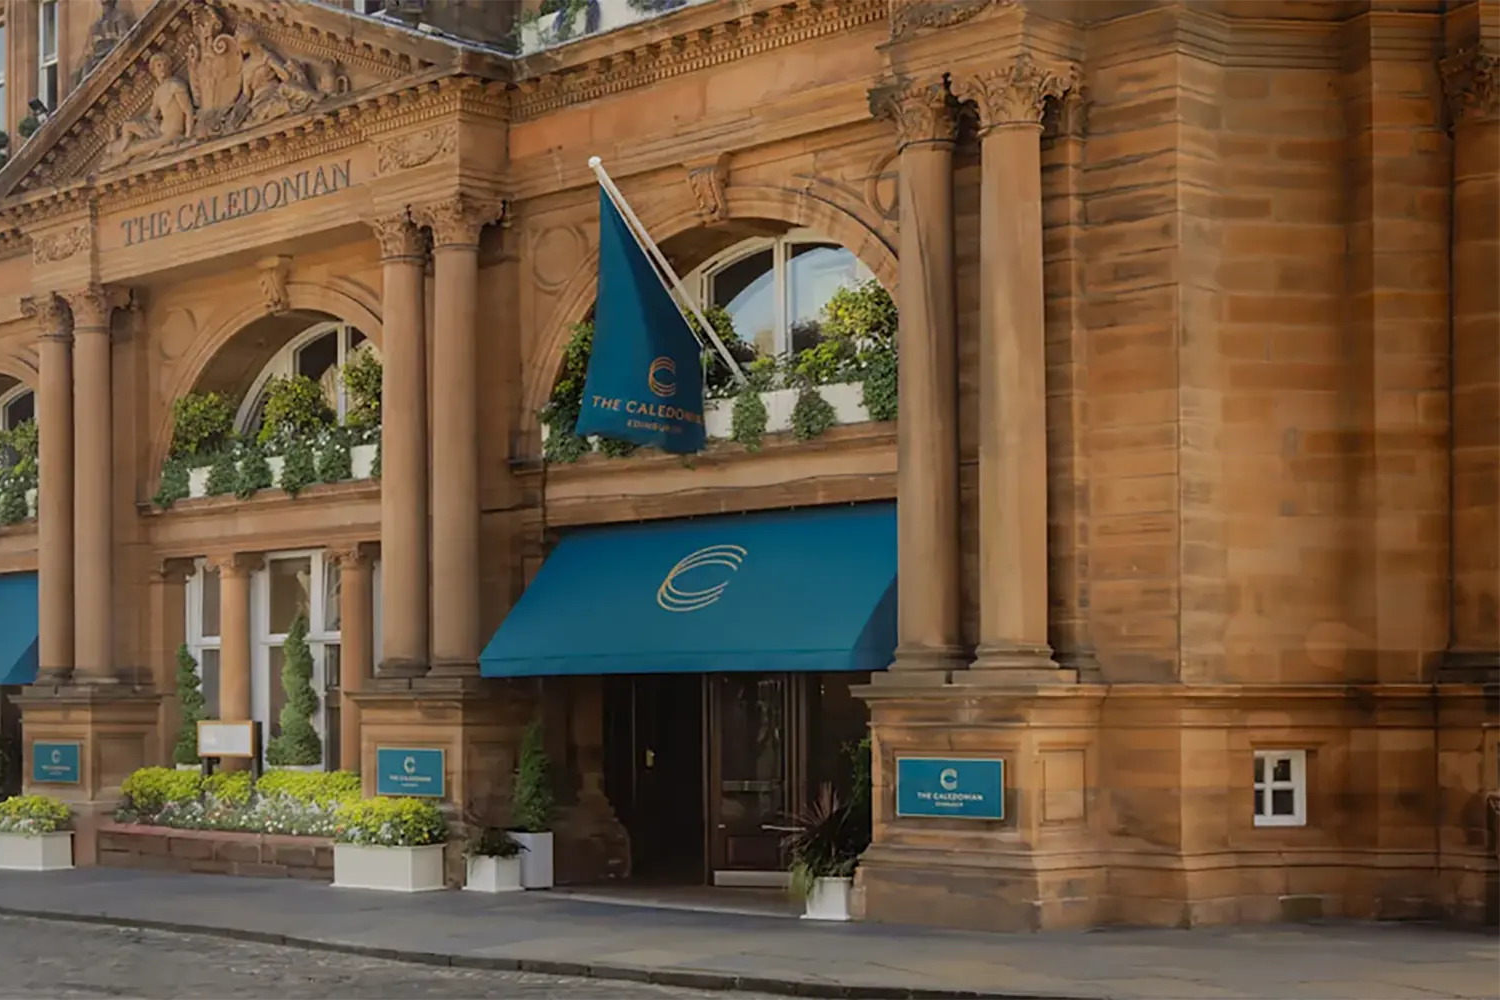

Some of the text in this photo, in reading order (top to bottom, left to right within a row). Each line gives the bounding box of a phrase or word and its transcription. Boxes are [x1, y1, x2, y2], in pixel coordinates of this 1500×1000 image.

[121, 158, 352, 247] THE CALEDONIAN
[592, 395, 621, 411] THE
